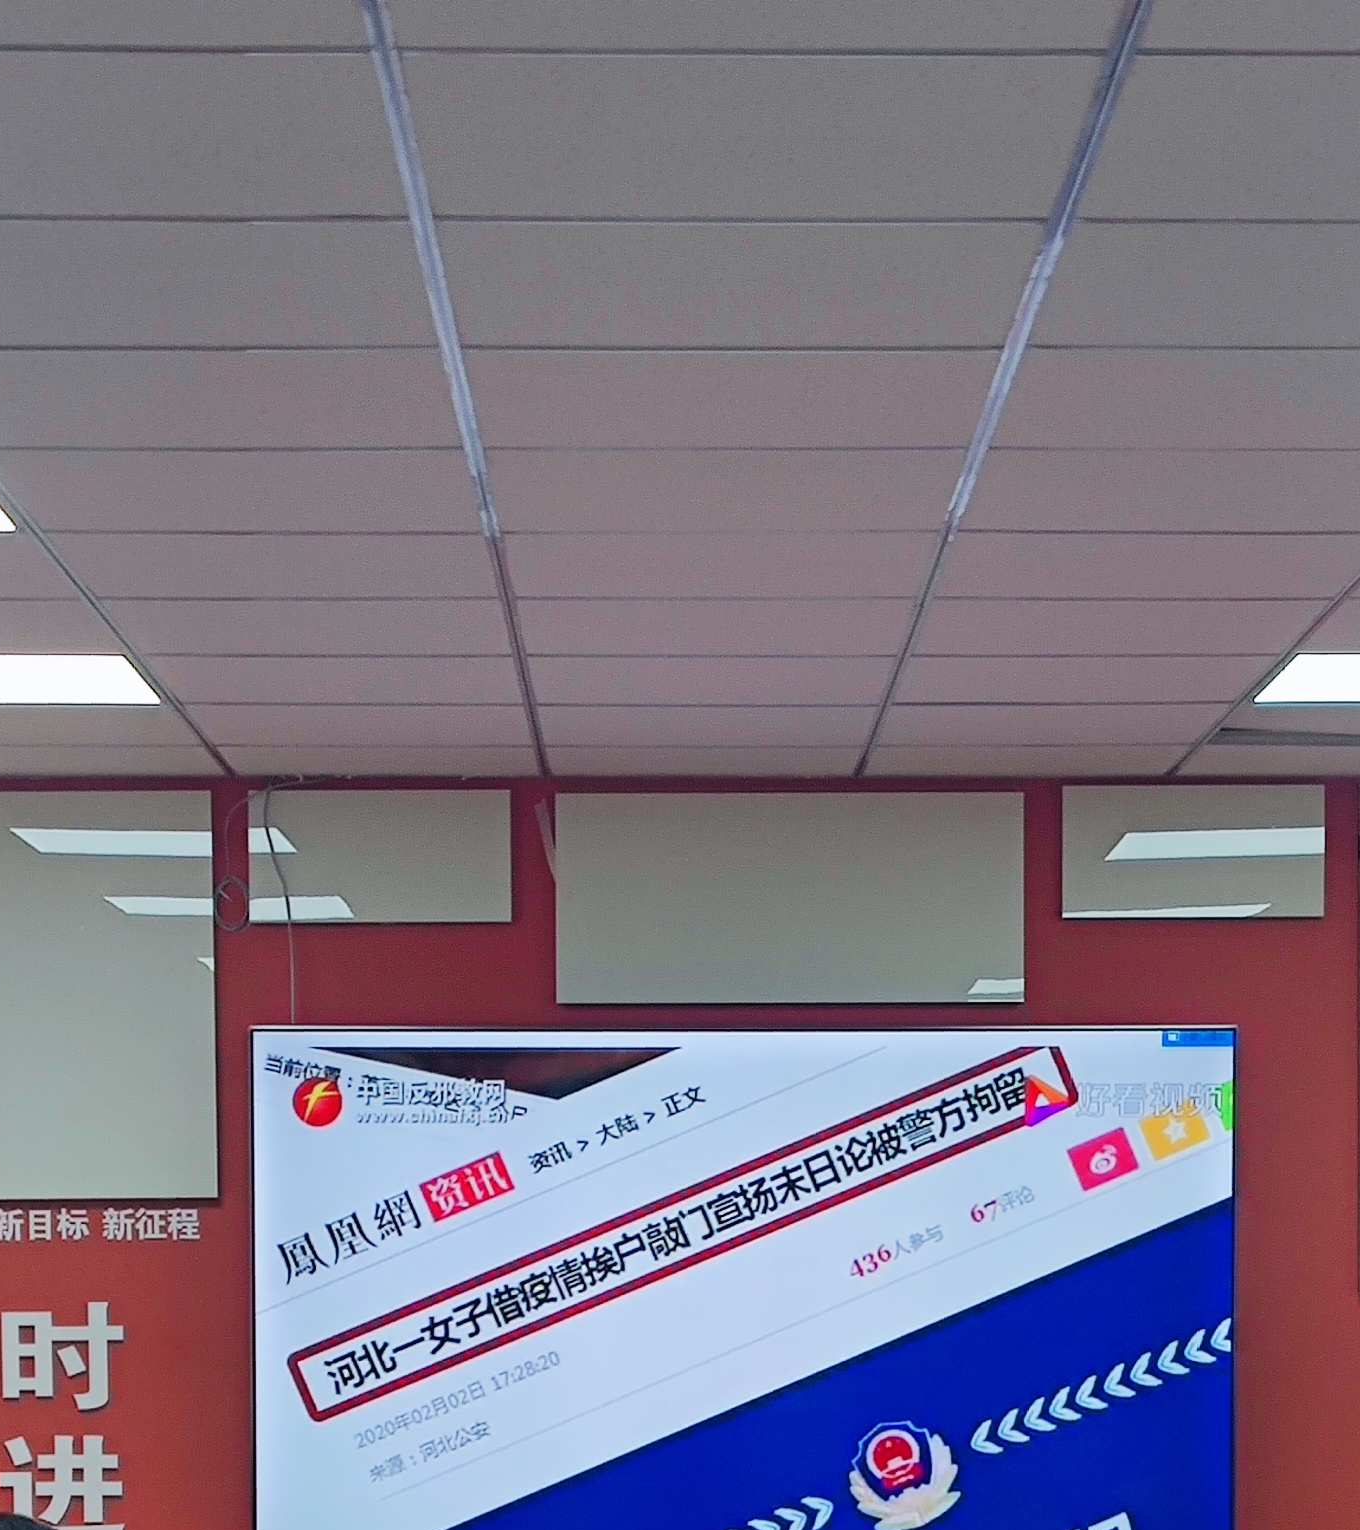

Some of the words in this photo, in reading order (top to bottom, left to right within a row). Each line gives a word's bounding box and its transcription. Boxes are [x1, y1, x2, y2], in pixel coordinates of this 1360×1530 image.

[528, 1141, 572, 1174] 资讯
[595, 1114, 639, 1146] 大陆
[660, 1086, 707, 1117] 正文
[427, 1154, 509, 1214] 资讯
[101, 1207, 201, 1242] 新征程
[490, 1350, 561, 1393] 17:28:20
